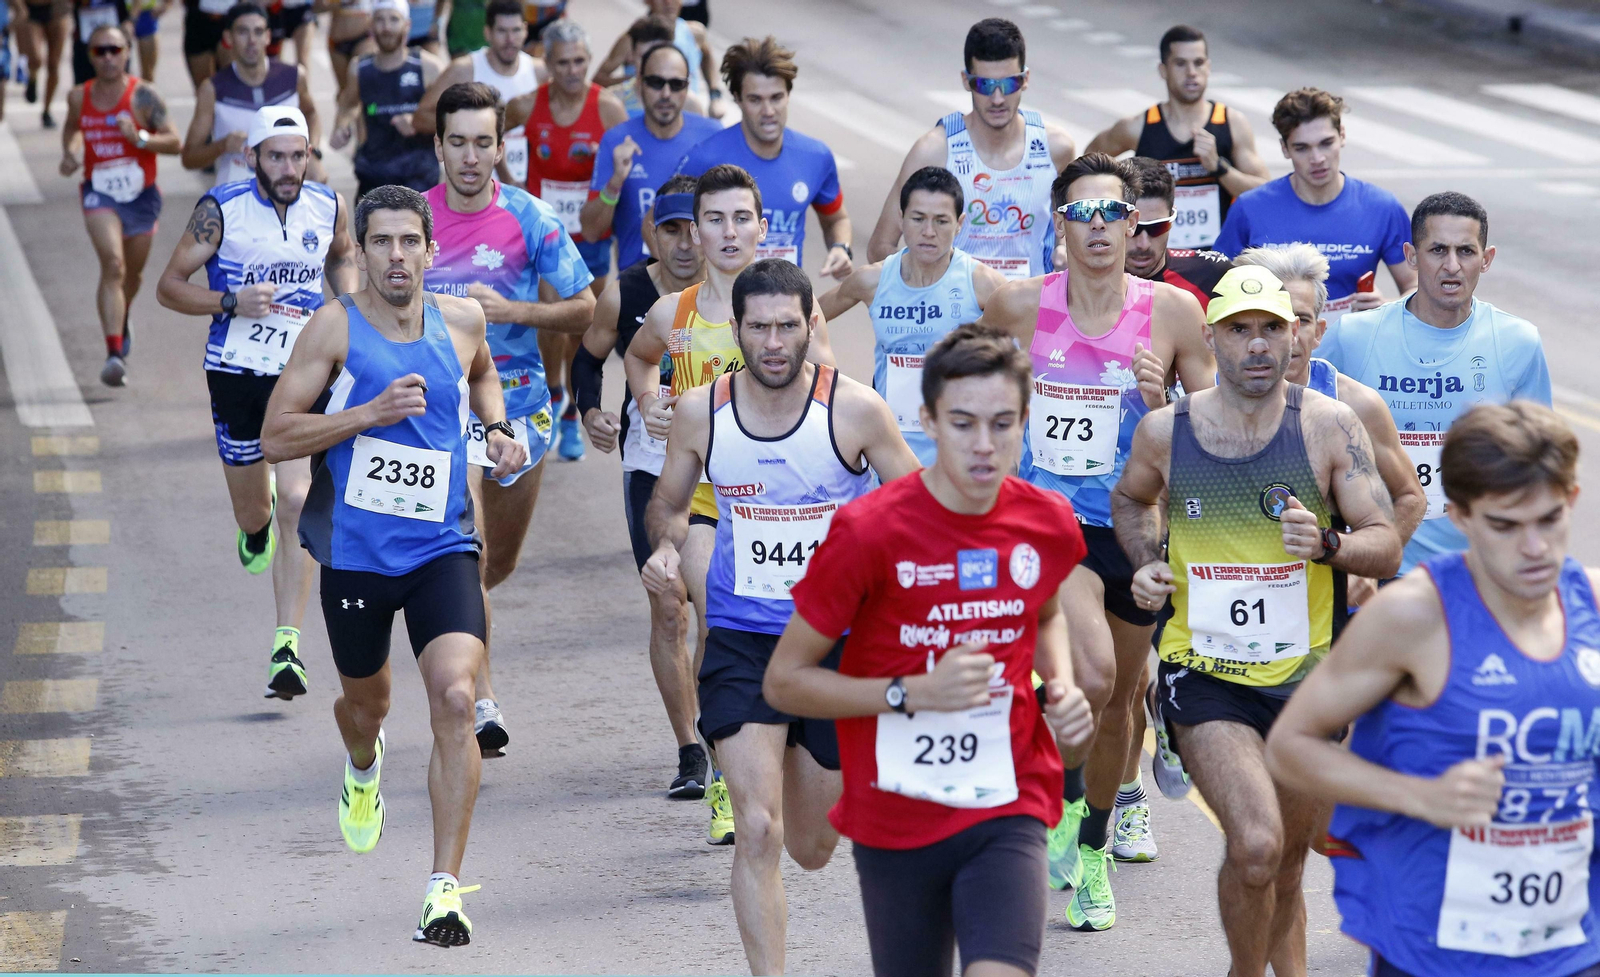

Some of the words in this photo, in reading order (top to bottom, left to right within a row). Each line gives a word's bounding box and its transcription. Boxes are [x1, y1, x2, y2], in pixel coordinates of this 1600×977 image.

[762, 208, 800, 233] M
[968, 198, 1035, 233] 2020
[271, 261, 304, 269] DEPORTIVO
[878, 301, 942, 325] nerja
[249, 323, 289, 349] 271
[885, 326, 933, 334] ATLETISMO
[890, 356, 904, 367] 41
[1043, 383, 1081, 395] CARRERA
[1082, 387, 1120, 397] URBANA
[1044, 391, 1064, 400] CIUDAD
[1378, 371, 1464, 399] nerja
[1389, 400, 1453, 410] ATLETISMO
[1046, 415, 1094, 441] 273
[1398, 433, 1437, 441] ARRERA
[367, 456, 435, 489] 2338
[733, 506, 752, 519] 41
[752, 507, 797, 516] CARRERA
[799, 503, 837, 515] URBANA
[1191, 566, 1213, 580] 41
[1213, 566, 1260, 575] CARRERA
[1263, 562, 1304, 575] URBANA
[1267, 580, 1301, 588] FEDERADO
[926, 599, 1025, 622] ATLETISMO
[1230, 598, 1266, 627] 61
[1187, 659, 1208, 672] LA
[1211, 663, 1251, 678] MIEL
[914, 733, 978, 765] 239
[1490, 871, 1563, 906] 360
